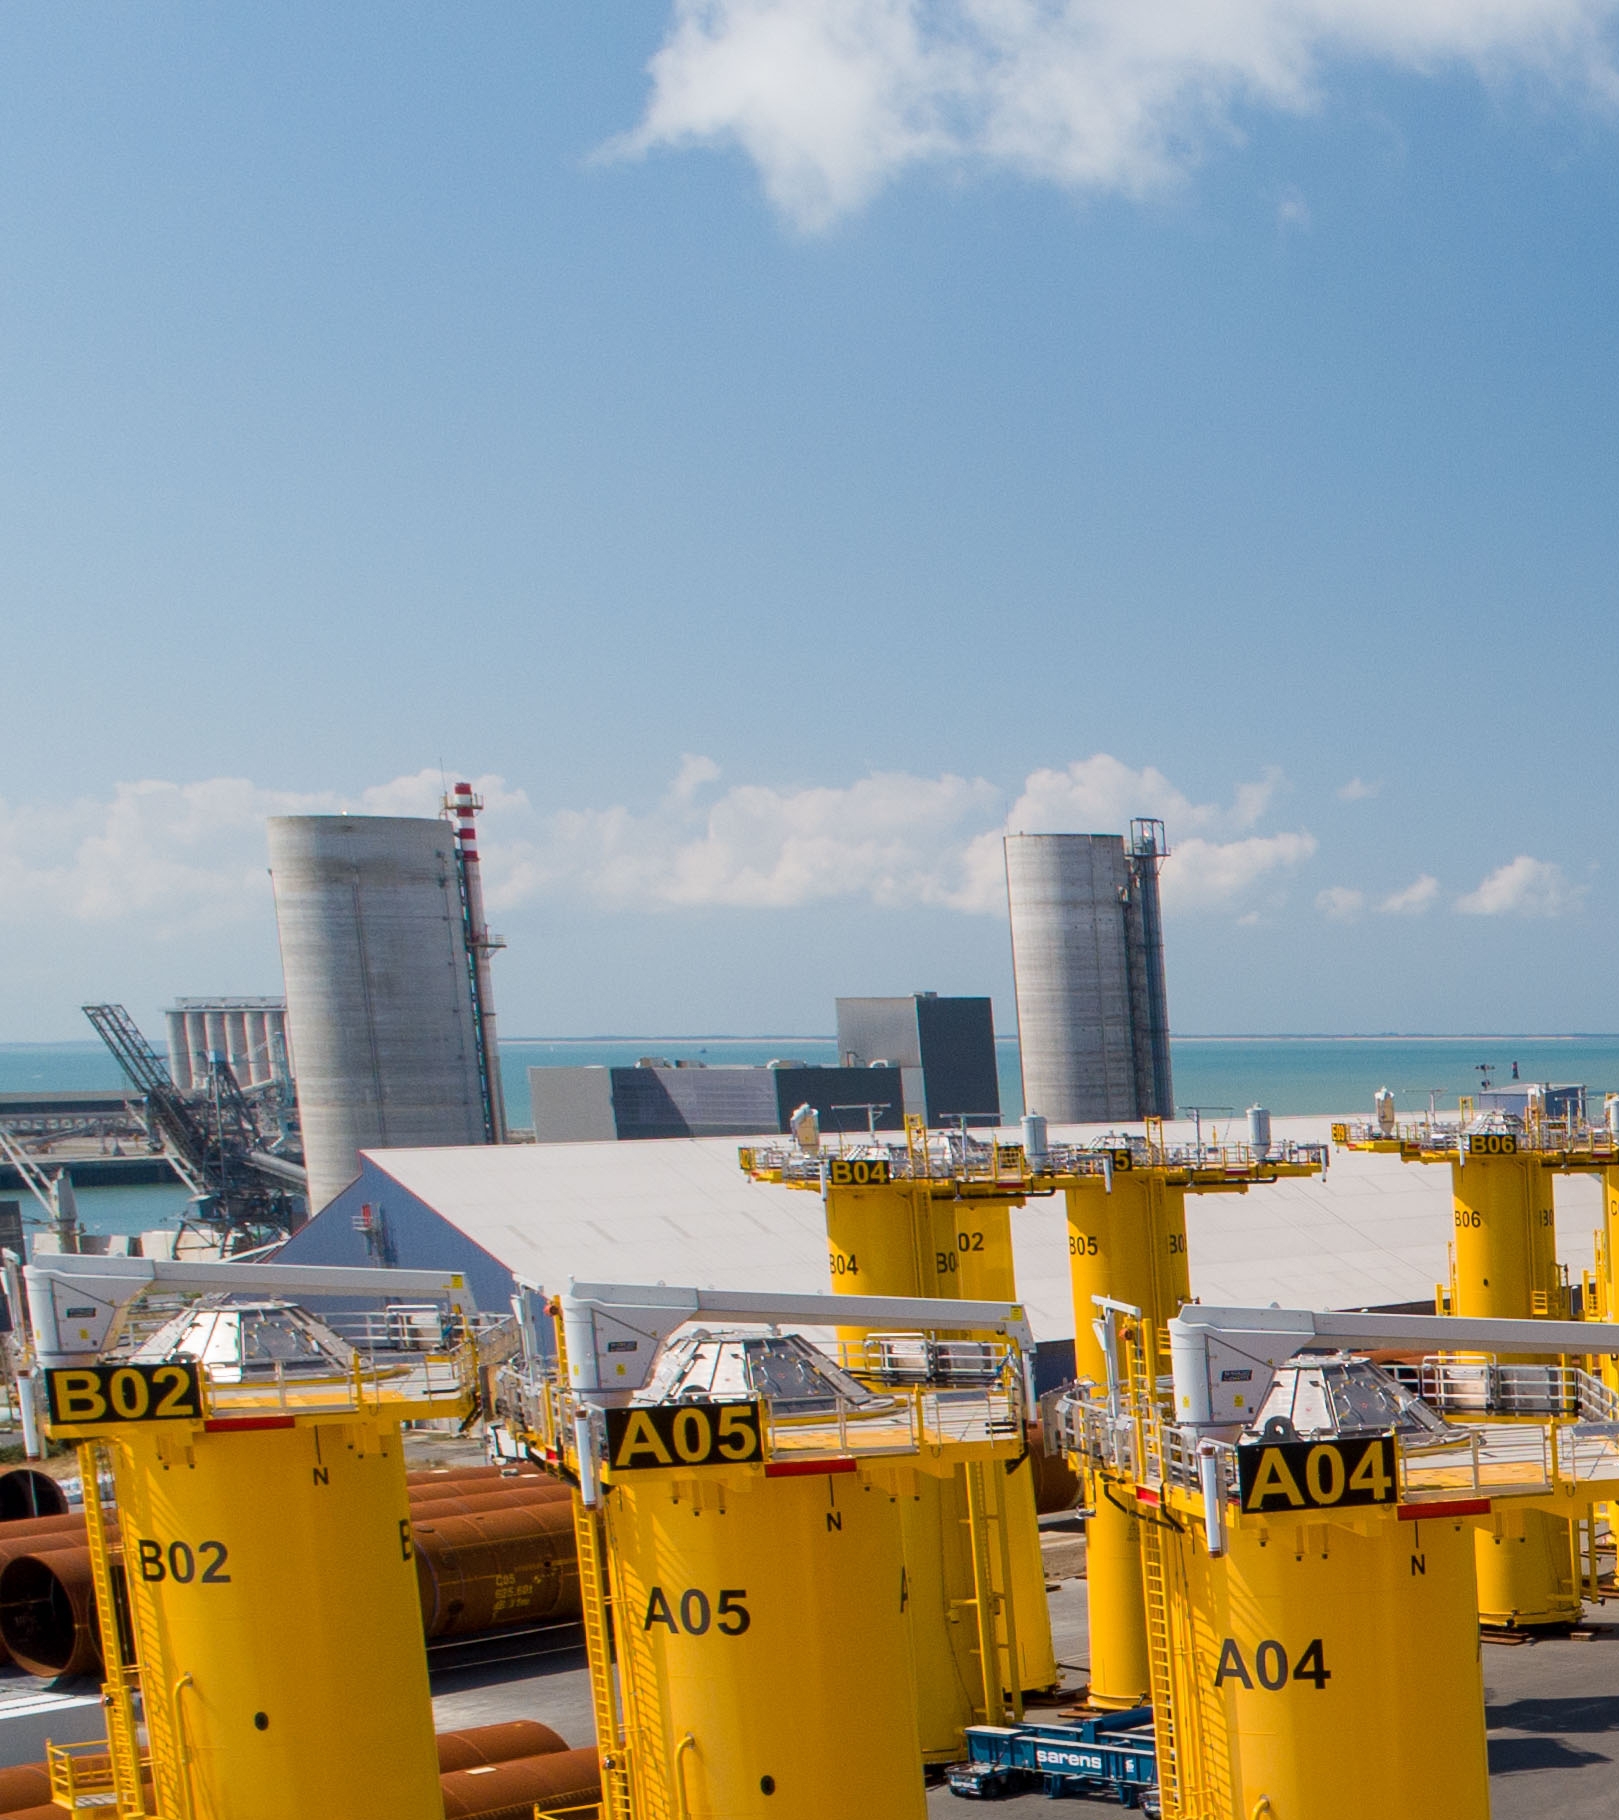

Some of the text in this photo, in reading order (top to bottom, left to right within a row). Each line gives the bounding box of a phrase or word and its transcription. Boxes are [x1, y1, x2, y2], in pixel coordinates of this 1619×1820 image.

[1471, 1135, 1515, 1154] B06
[832, 1161, 887, 1184] B04
[1454, 1210, 1481, 1228] B06
[52, 1366, 194, 1422] B02
[615, 1406, 757, 1467] A05
[313, 1467, 329, 1486] N
[1247, 1441, 1392, 1509] A04
[826, 1512, 842, 1532] N
[138, 1539, 231, 1583] B02
[1411, 1554, 1425, 1576] N
[643, 1586, 750, 1636] A05
[1214, 1638, 1331, 1691] A04
[1036, 1750, 1102, 1769] sarens
